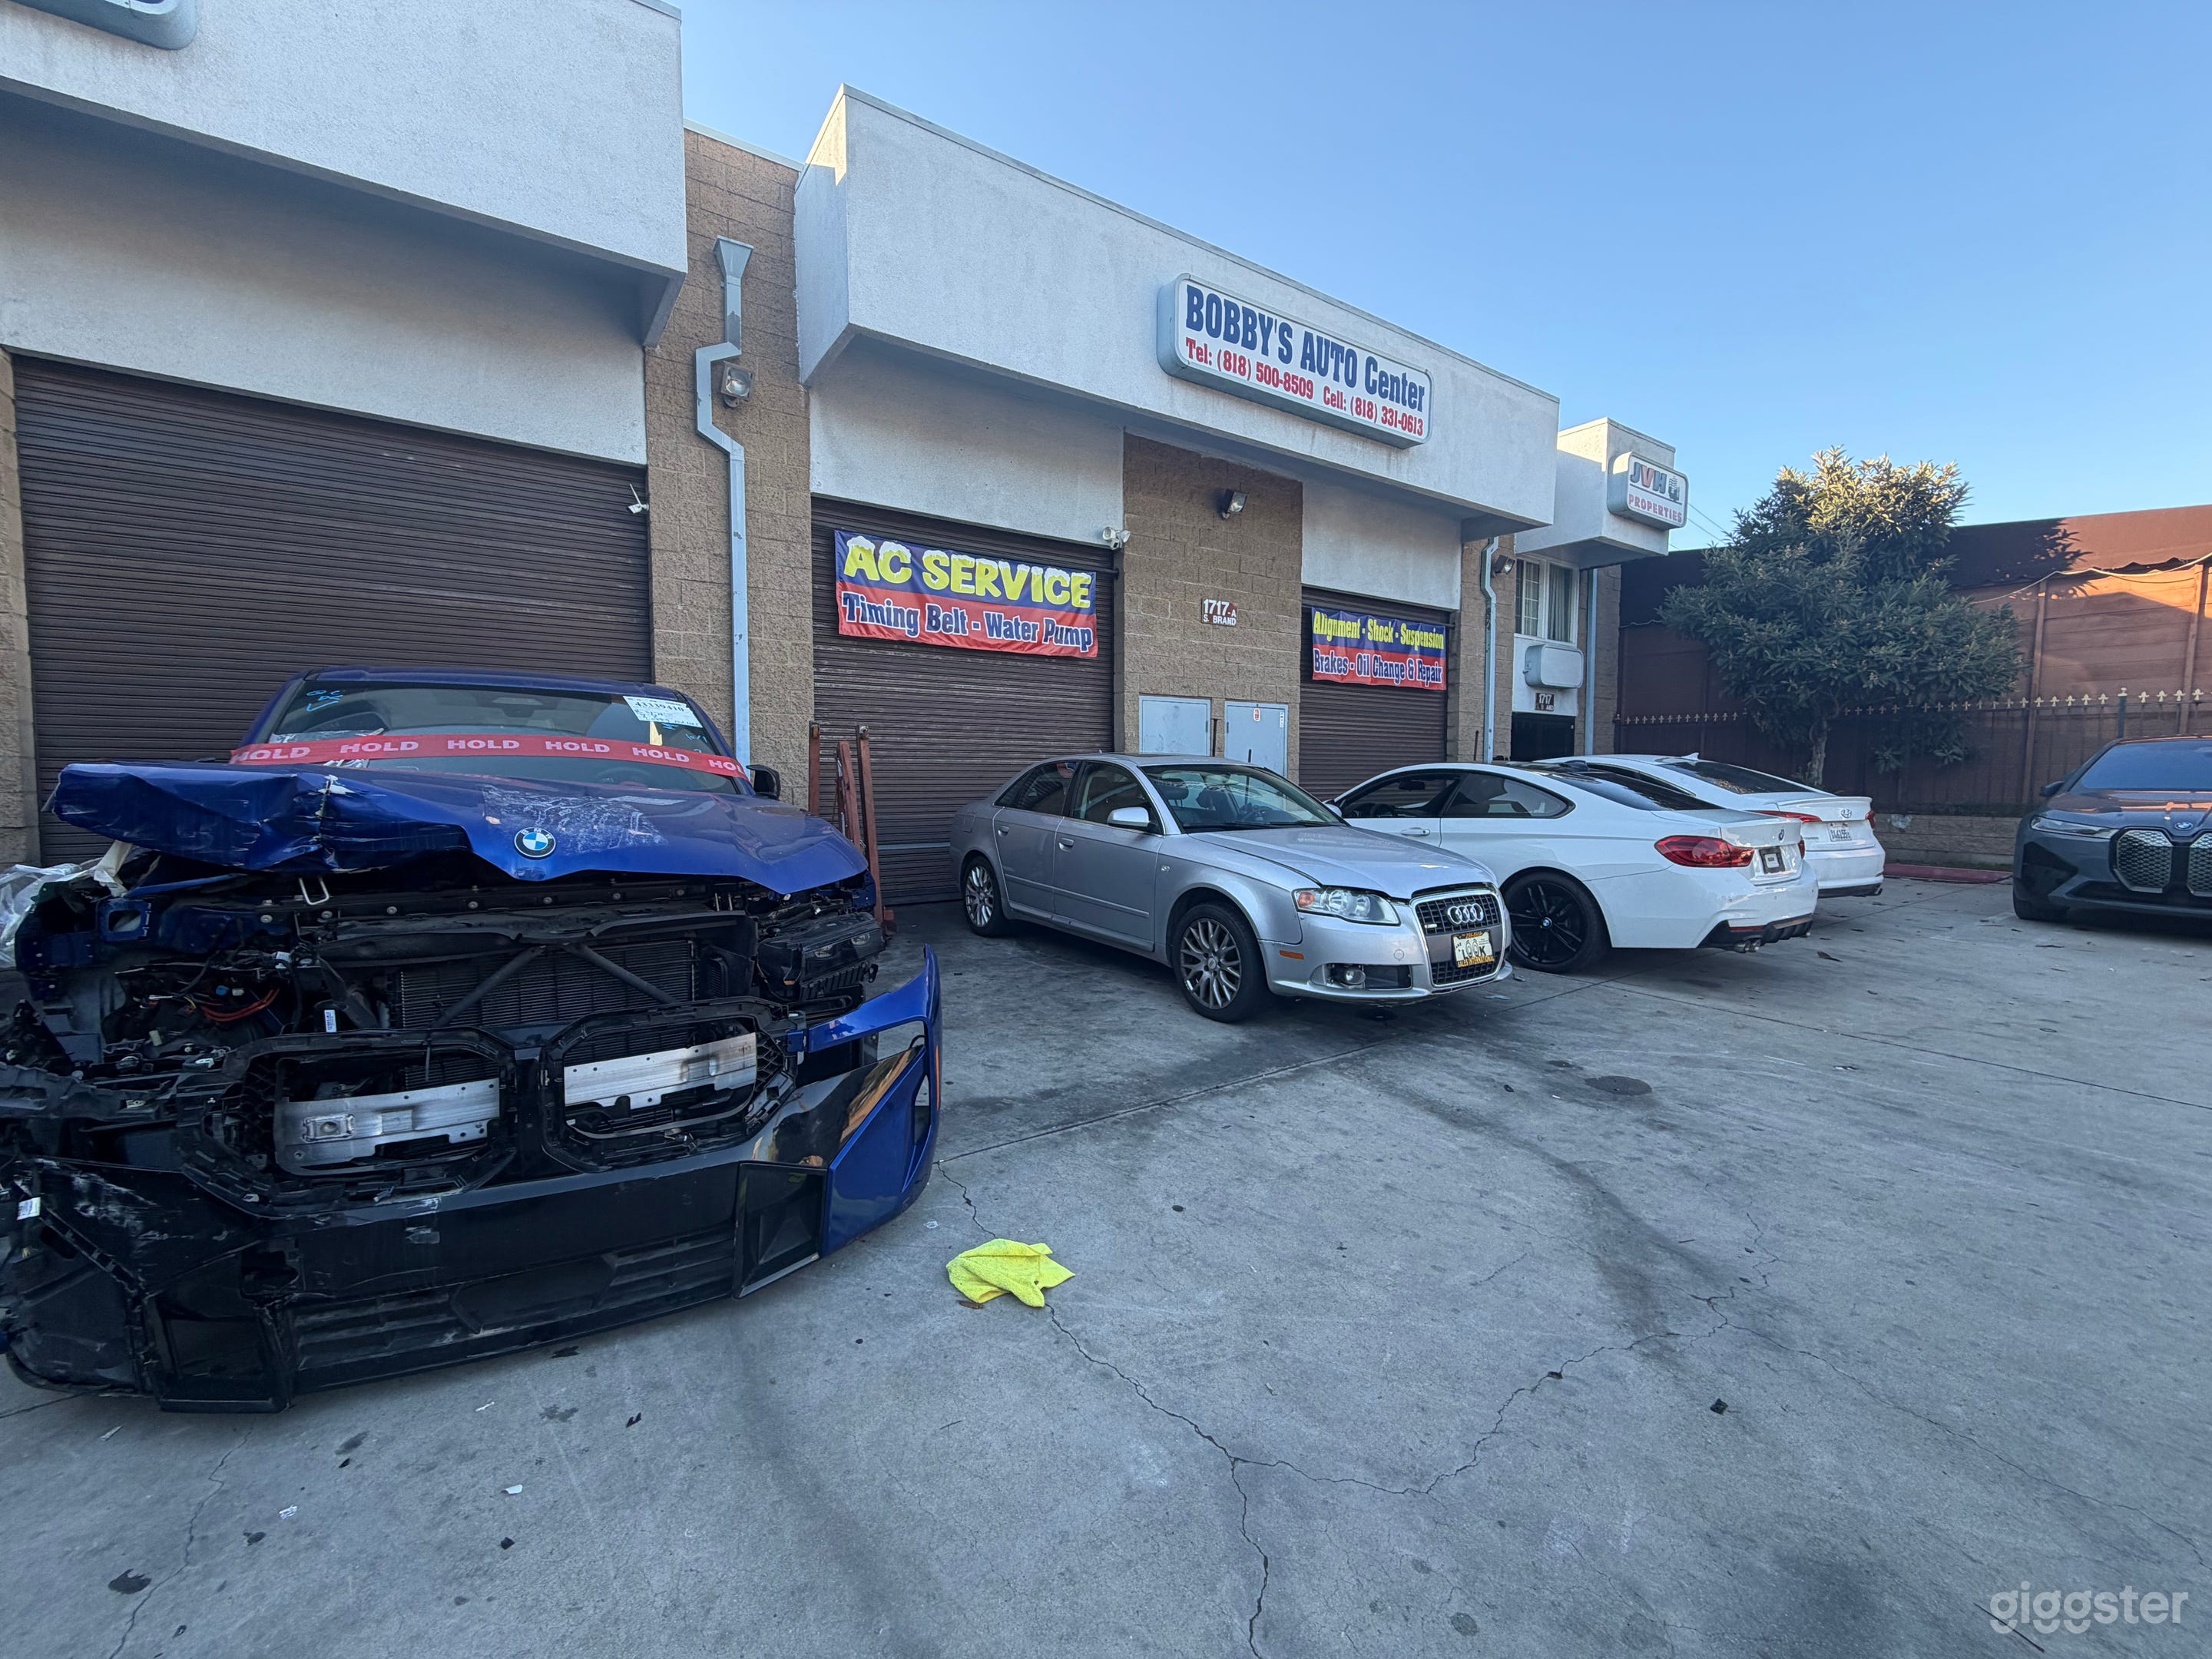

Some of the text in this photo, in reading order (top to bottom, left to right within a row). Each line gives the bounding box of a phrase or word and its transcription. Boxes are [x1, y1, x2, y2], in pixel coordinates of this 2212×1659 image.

[1185, 284, 1426, 412] BOBBY'S AUTO Center
[1185, 336, 1423, 437] Tel: (818) 500-8509 Cell: (818) 331-0613
[1630, 462, 1667, 494] JVH
[1628, 493, 1683, 523] PROPERTIES
[843, 535, 1091, 608] AC SERVICE
[841, 591, 921, 638] Timing
[926, 604, 969, 636] Belt
[984, 611, 1039, 644] Water
[1042, 618, 1094, 653] Pump
[1213, 615, 1237, 626] BRAND
[1313, 611, 1361, 642] Alignment
[1367, 618, 1394, 643] Shock
[1400, 623, 1445, 651] Suspension
[1313, 648, 1349, 676] Brakes
[1356, 652, 1371, 677] Oil
[1372, 654, 1406, 686] Change
[1406, 657, 1415, 680] &
[1416, 658, 1442, 687] Repair
[231, 740, 745, 774] HOLD HOLD HOLD HOLD HOLD HOL
[521, 828, 554, 839] BMW
